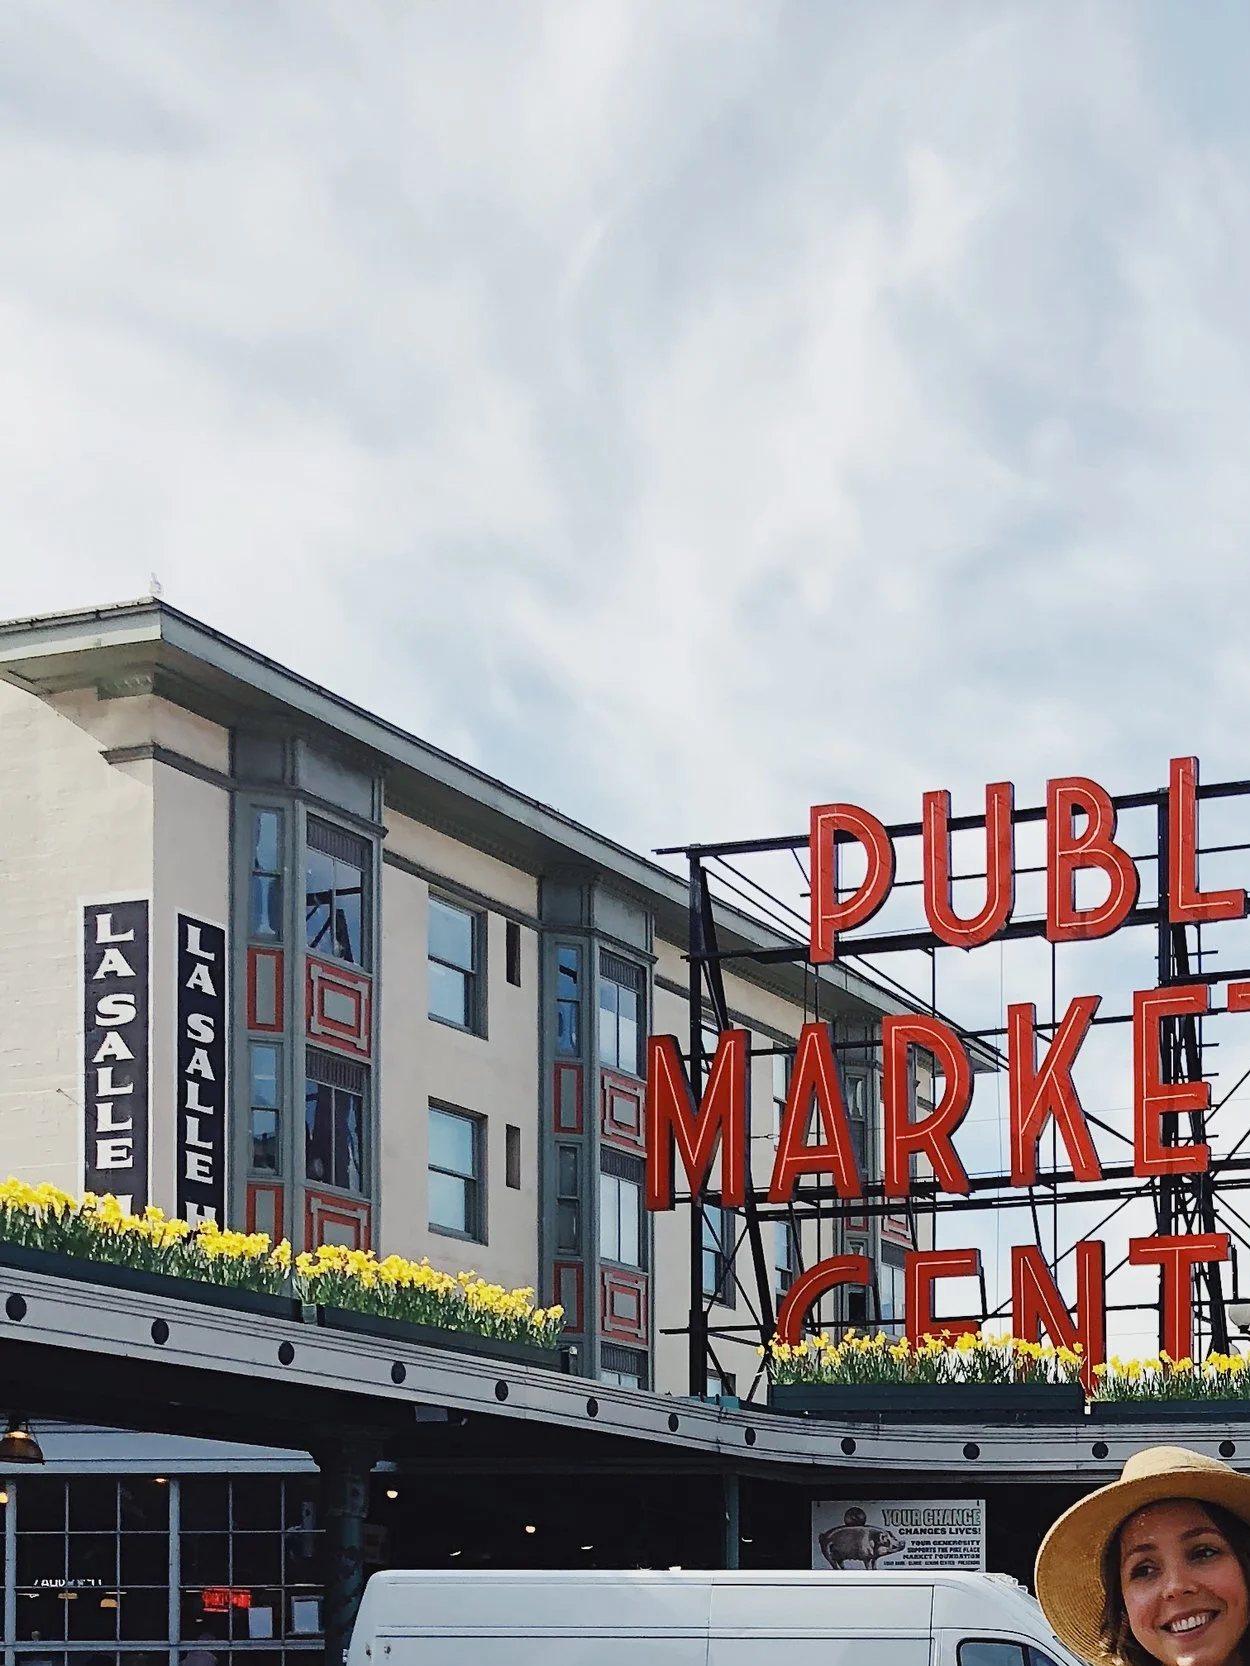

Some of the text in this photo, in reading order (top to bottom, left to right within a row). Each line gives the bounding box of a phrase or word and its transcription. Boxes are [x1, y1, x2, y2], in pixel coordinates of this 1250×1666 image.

[92, 912, 137, 980] LA
[185, 923, 218, 998] LA
[92, 992, 137, 1170] SALLE
[185, 1012, 216, 1185] SALLE
[881, 1508, 981, 1527] YOUR CHANGE
[899, 1527, 981, 1535] CHANGES LIVES!
